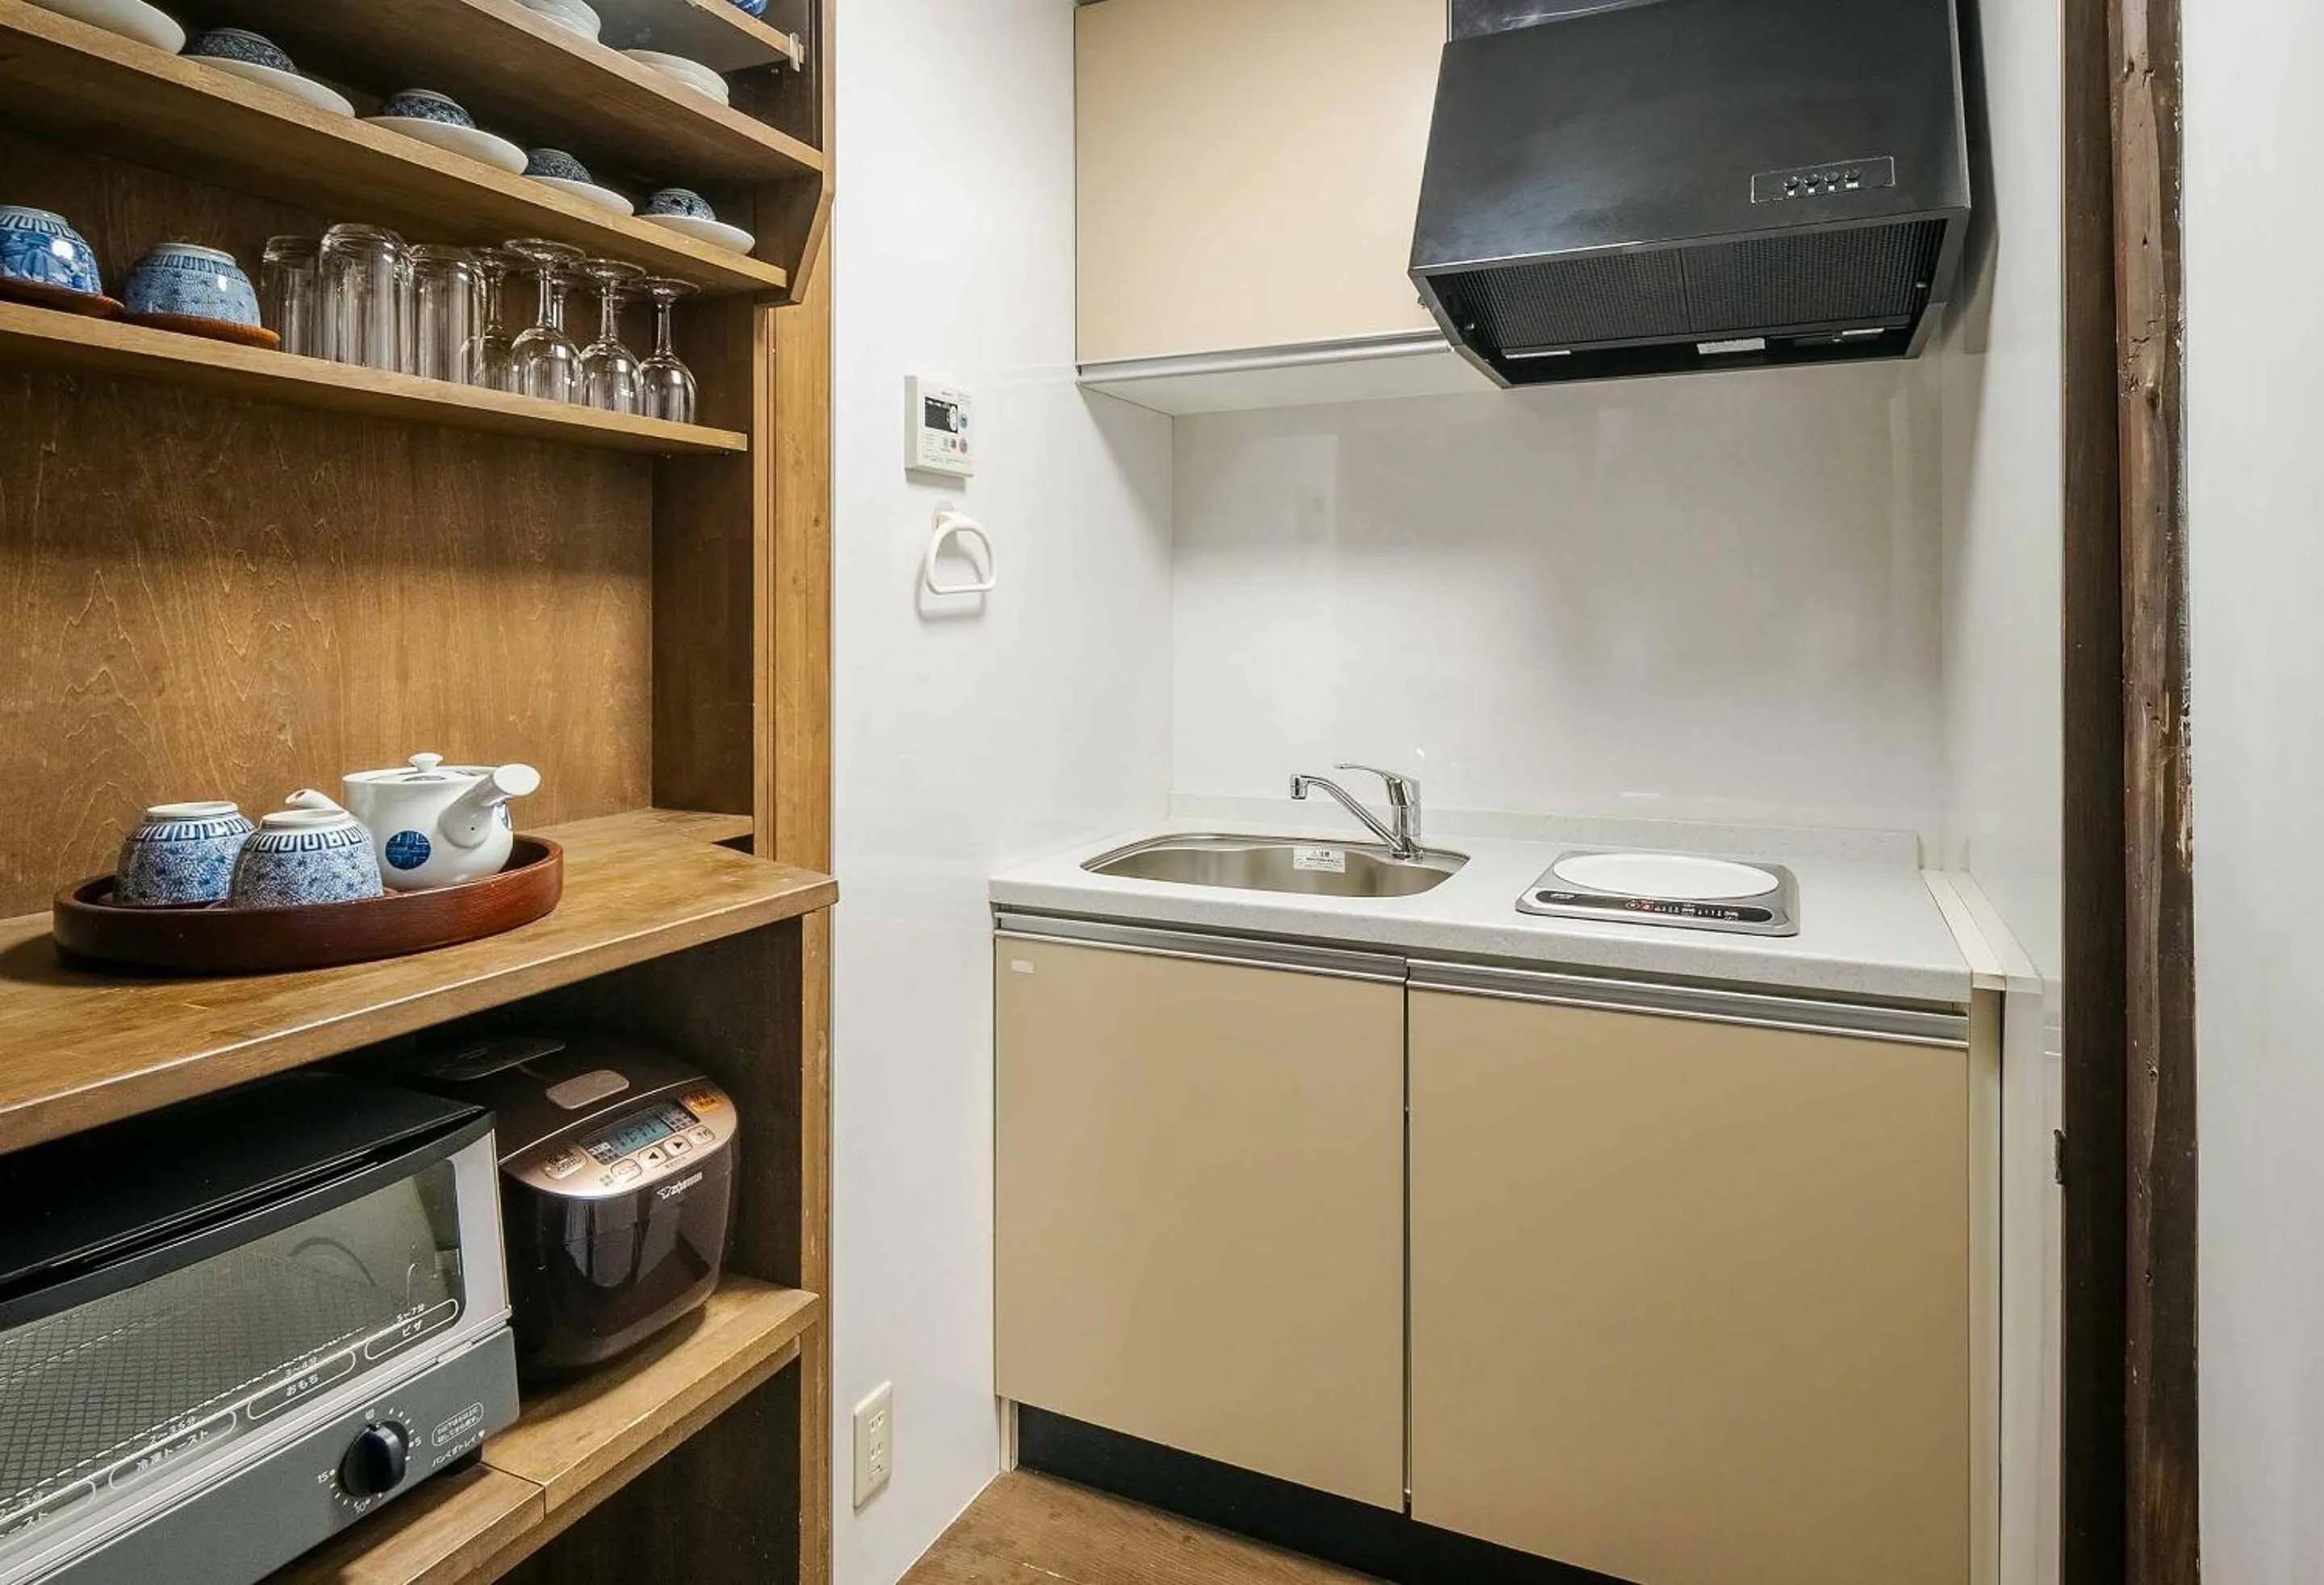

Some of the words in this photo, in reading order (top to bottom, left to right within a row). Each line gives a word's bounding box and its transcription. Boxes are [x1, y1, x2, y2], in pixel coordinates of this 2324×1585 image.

[414, 1436, 422, 1447] 5
[317, 1471, 329, 1484] 15
[353, 1501, 366, 1513] 10
